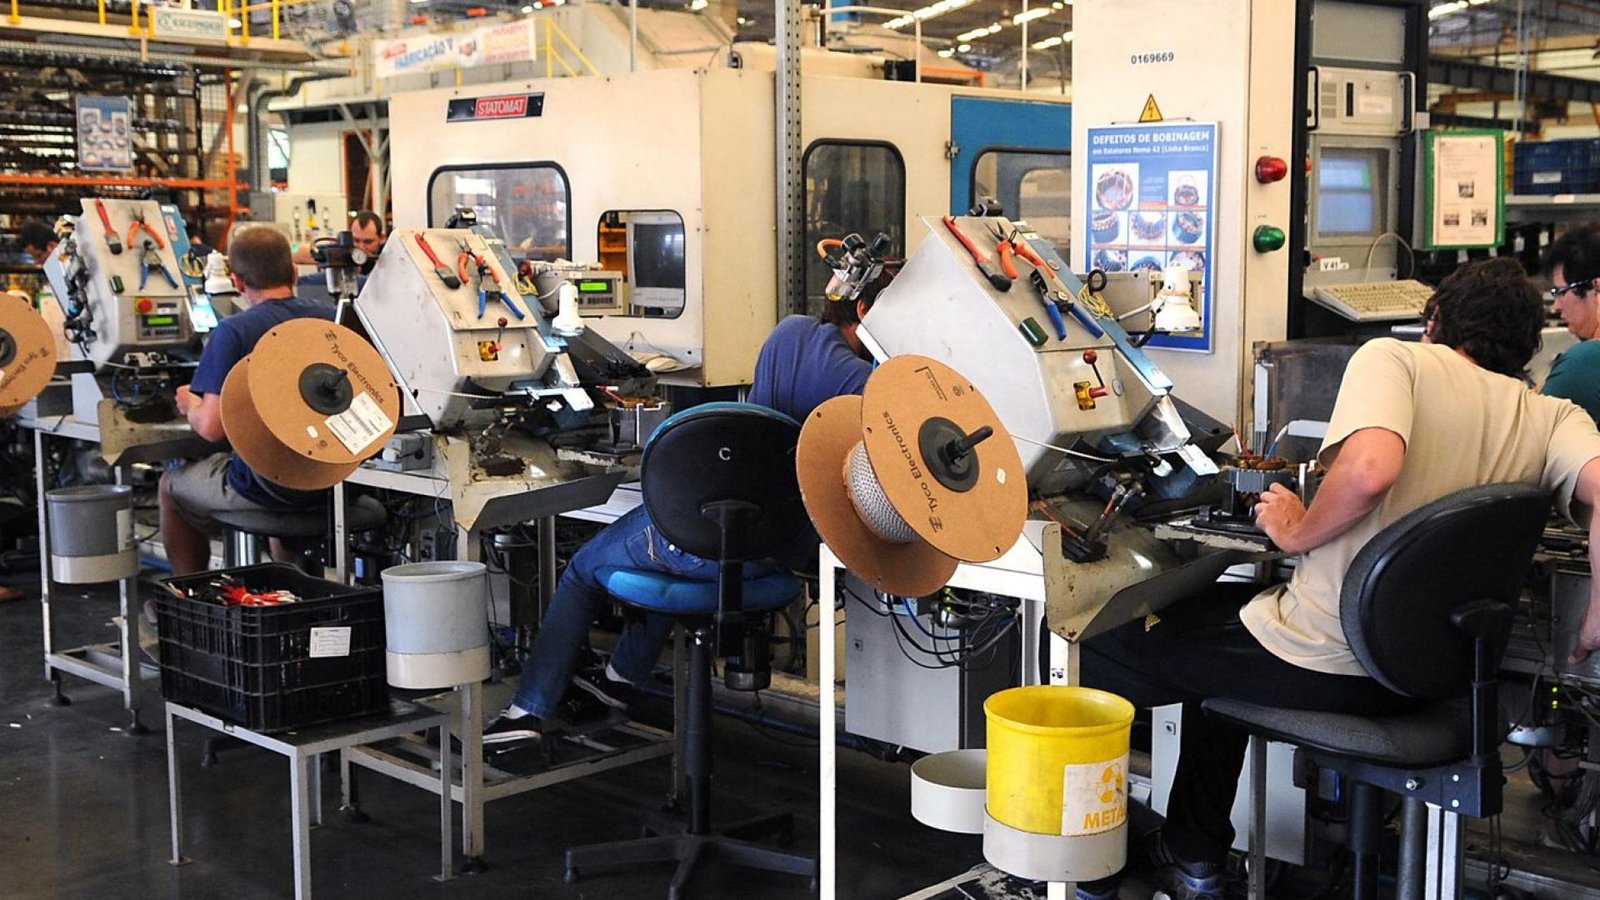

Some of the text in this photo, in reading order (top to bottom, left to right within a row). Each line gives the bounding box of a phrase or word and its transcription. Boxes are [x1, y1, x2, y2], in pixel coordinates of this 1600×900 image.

[1130, 51, 1174, 64] 0169669
[478, 98, 525, 115] STATOMAT
[1092, 130, 1210, 145] DEFEITOS DE BOBINAGEM
[331, 343, 385, 404] Tyco Electronics
[718, 446, 731, 461] C
[881, 411, 939, 513] Tyco Electronics
[1083, 804, 1127, 829] META
